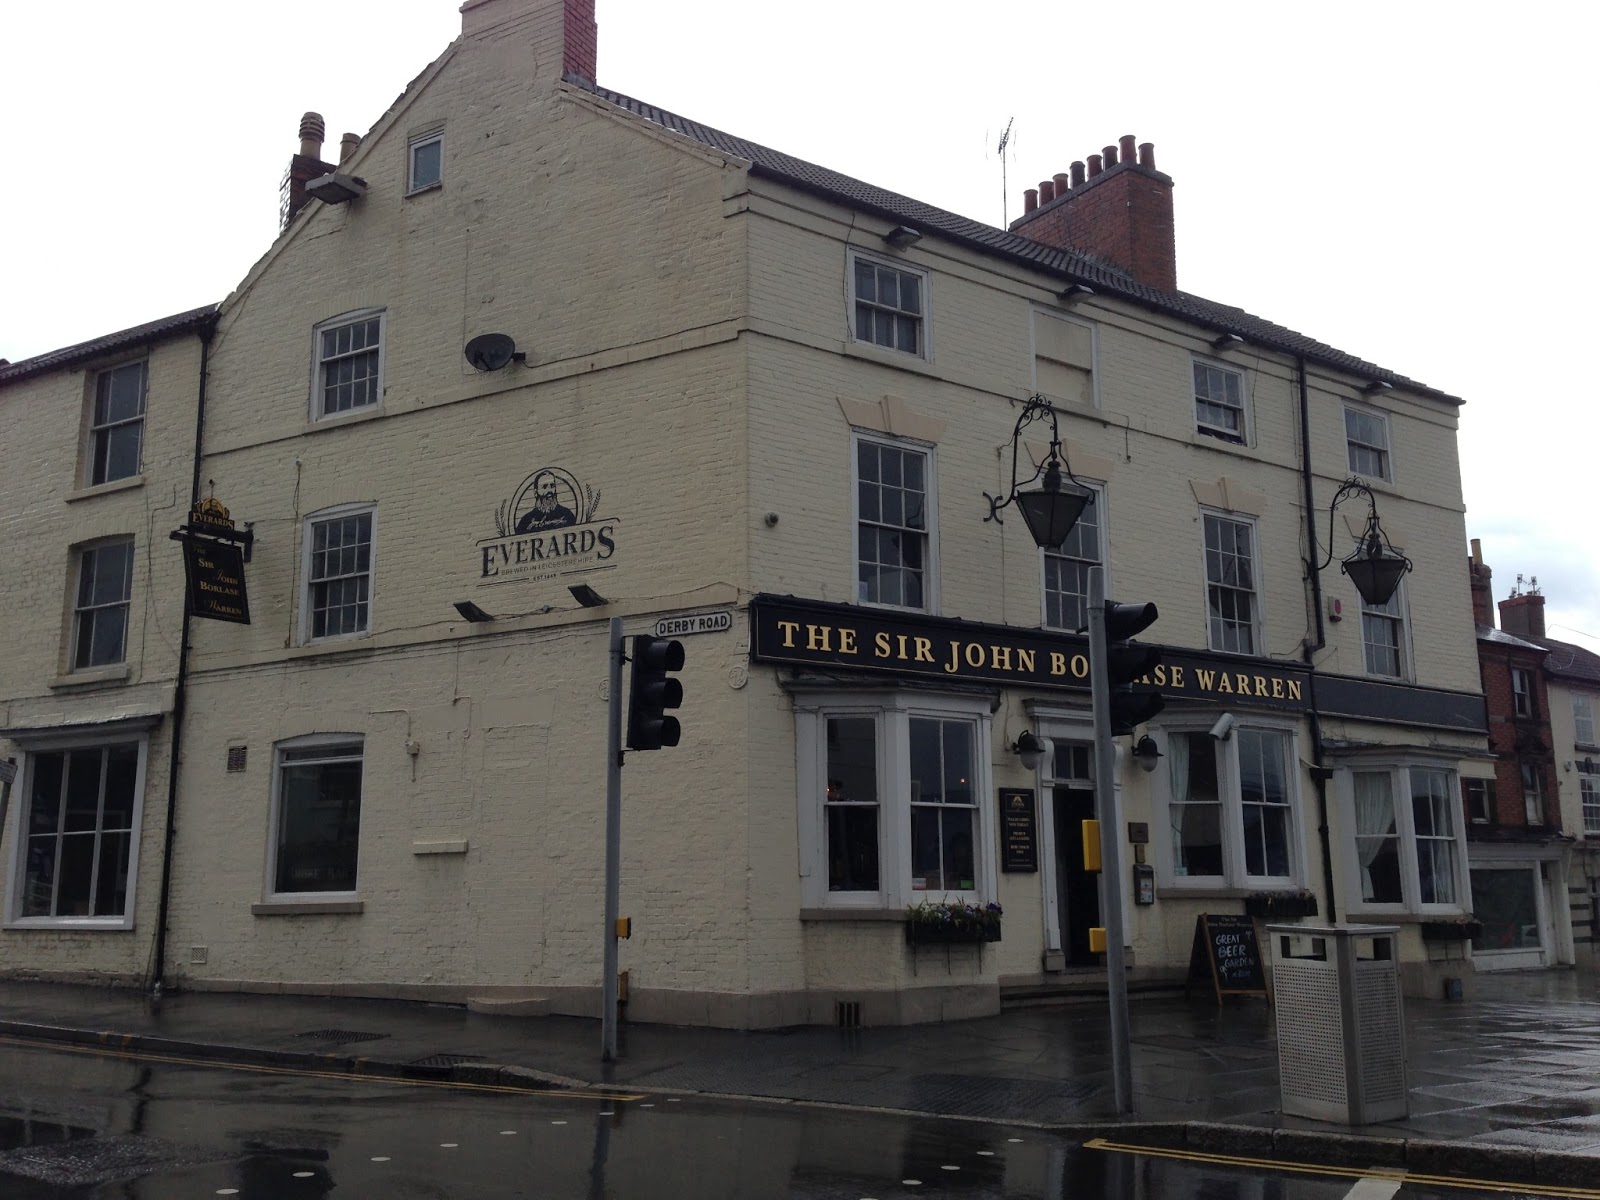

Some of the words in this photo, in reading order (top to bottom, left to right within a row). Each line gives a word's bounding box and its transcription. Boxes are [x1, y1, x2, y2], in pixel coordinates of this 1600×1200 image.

[192, 512, 234, 530] EVERARDS
[480, 526, 615, 579] EVERARDS
[198, 557, 215, 569] SIR
[200, 581, 240, 596] BORLASE
[659, 618, 696, 634] DERBY
[699, 615, 728, 630] ROAD
[777, 621, 858, 655] THE
[874, 631, 936, 663] SIR
[944, 641, 1036, 674] JOHN
[1195, 668, 1302, 701] WARREN
[1215, 933, 1240, 946] GREAT
[1218, 945, 1246, 958] BEER
[1224, 957, 1254, 968] GARDEN
